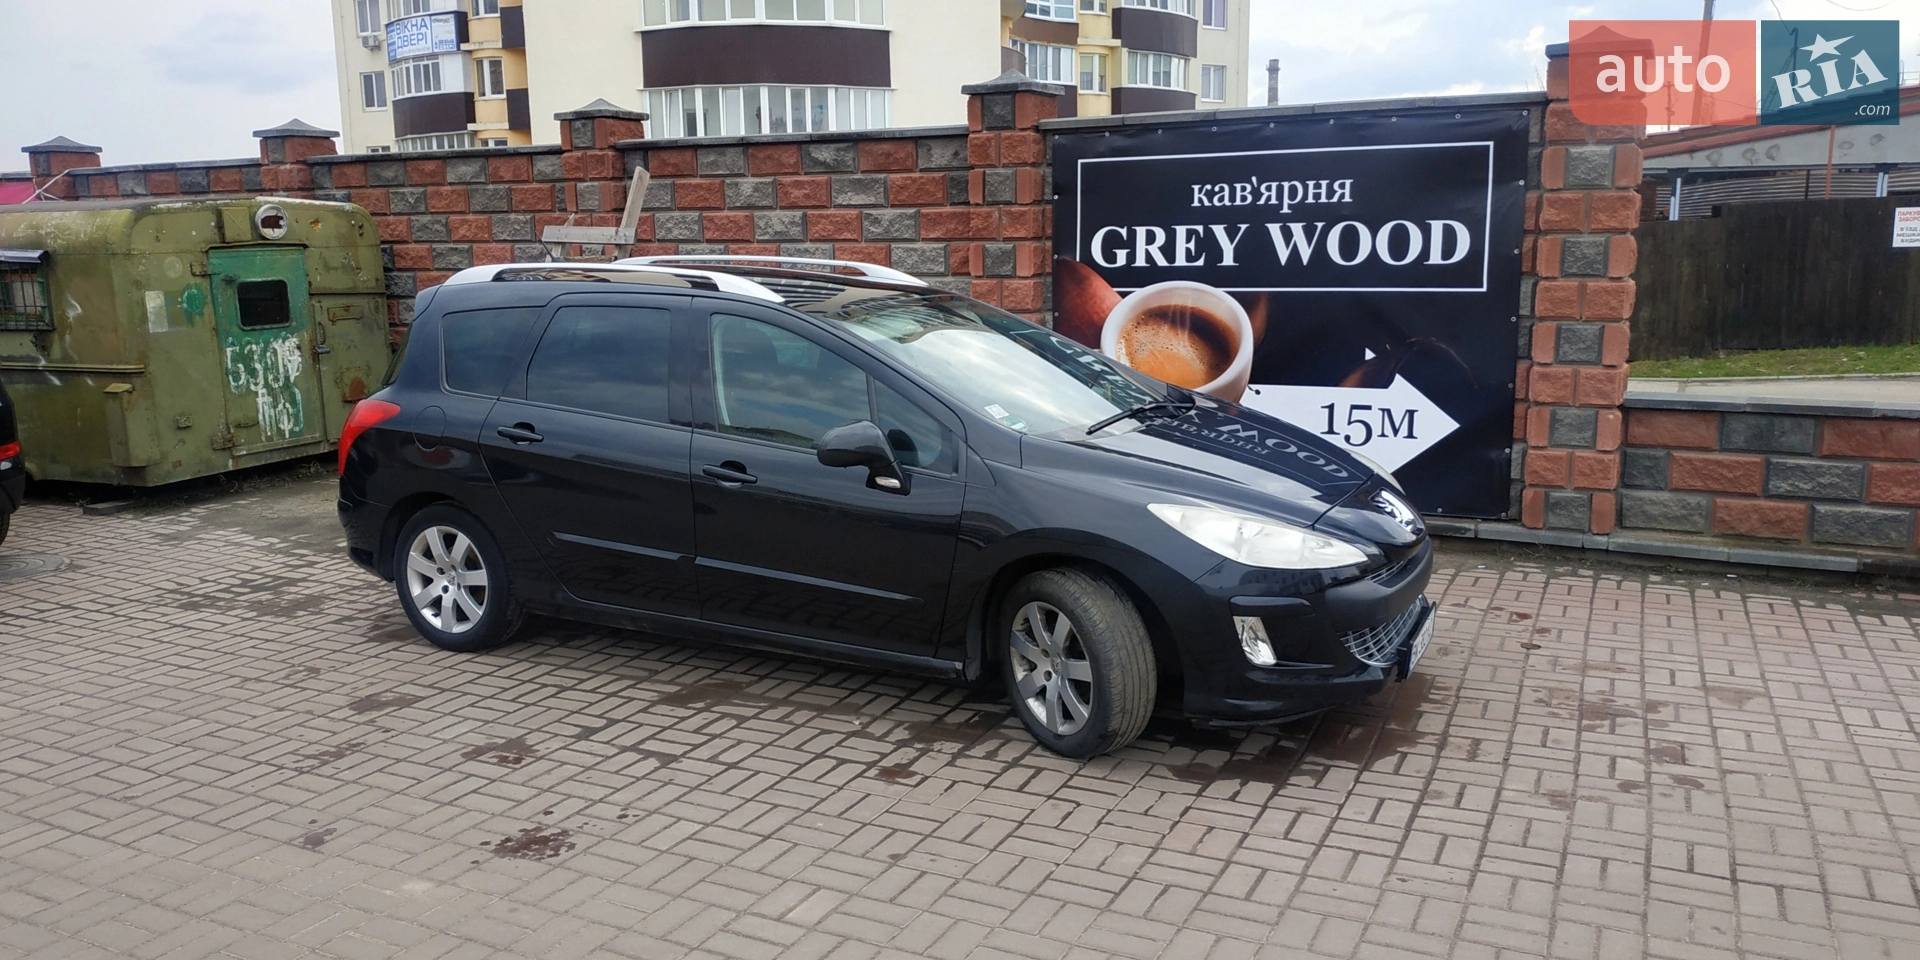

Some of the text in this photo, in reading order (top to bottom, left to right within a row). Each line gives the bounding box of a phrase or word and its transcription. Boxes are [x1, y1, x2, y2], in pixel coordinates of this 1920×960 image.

[395, 18, 429, 35] ВІКНА
[397, 31, 428, 50] ДВЕРІ
[1190, 176, 1354, 213] кав'ярня
[1090, 219, 1471, 268] GREY WOOD
